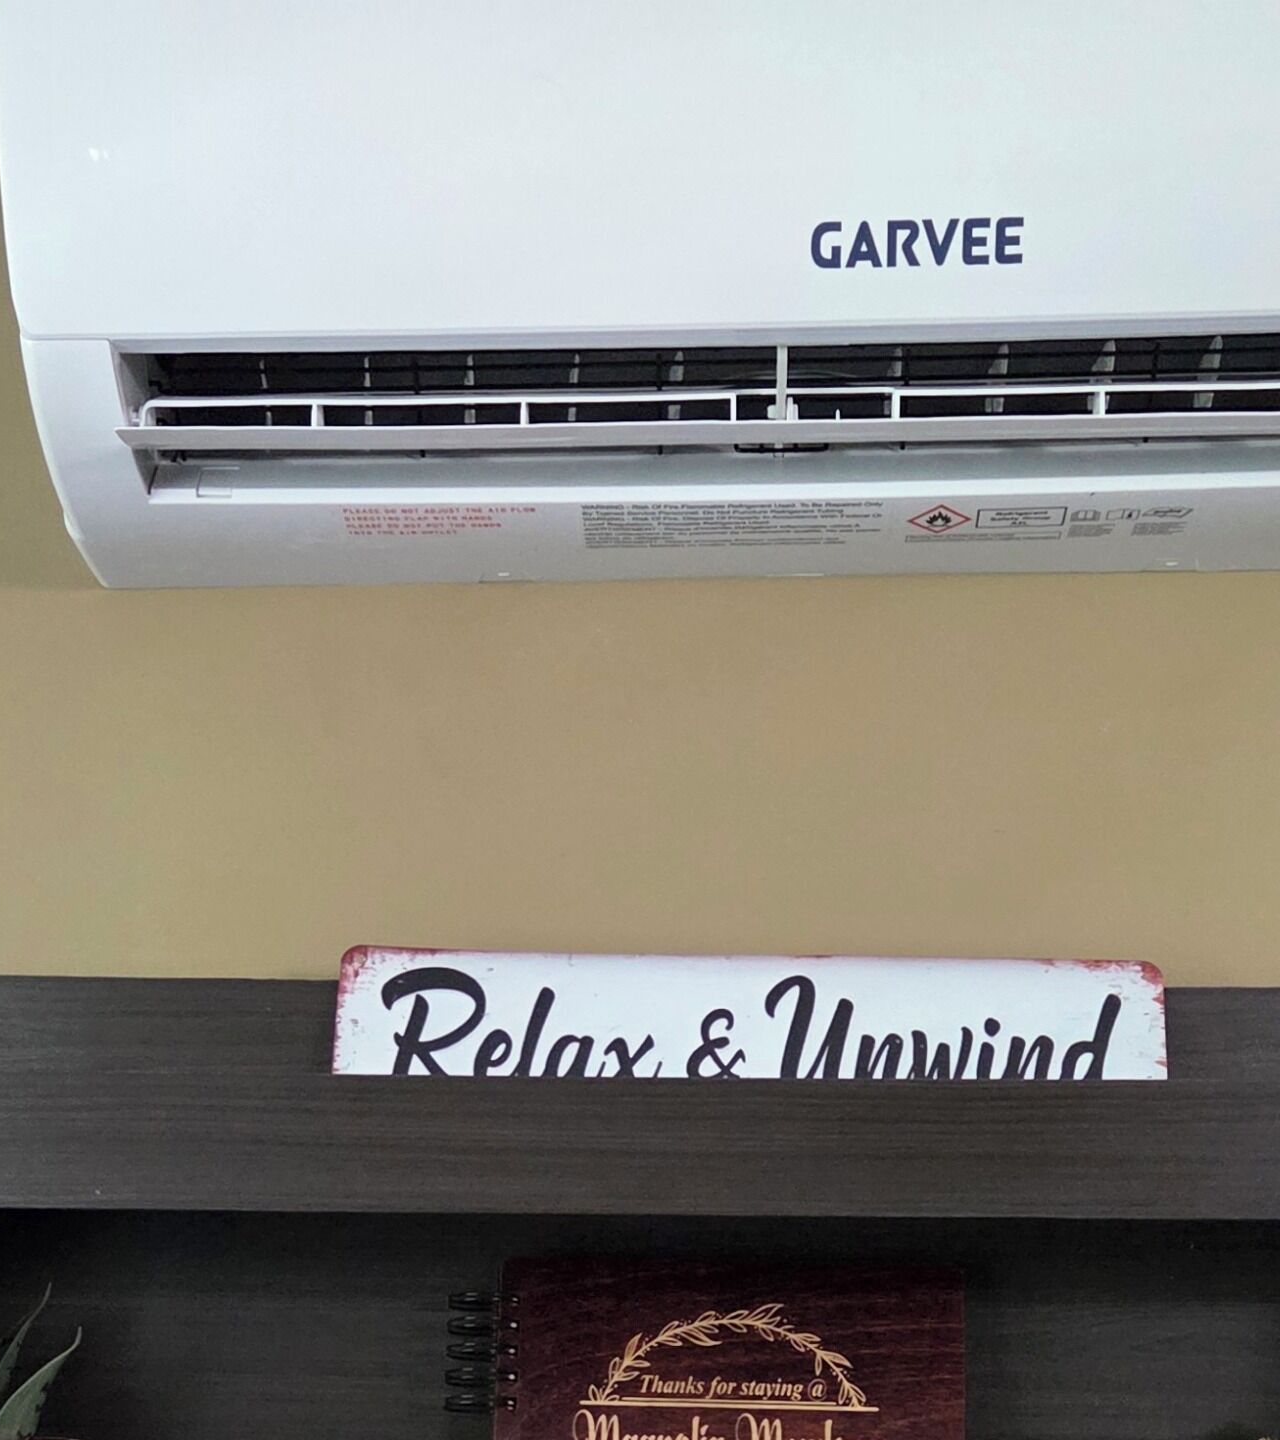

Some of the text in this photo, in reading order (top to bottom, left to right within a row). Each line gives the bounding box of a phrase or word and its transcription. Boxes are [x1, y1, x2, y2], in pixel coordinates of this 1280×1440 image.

[811, 216, 1024, 268] GARVEE
[381, 967, 1122, 1079] Relax & Unwind
[640, 1374, 828, 1400] Thanks for staying @
